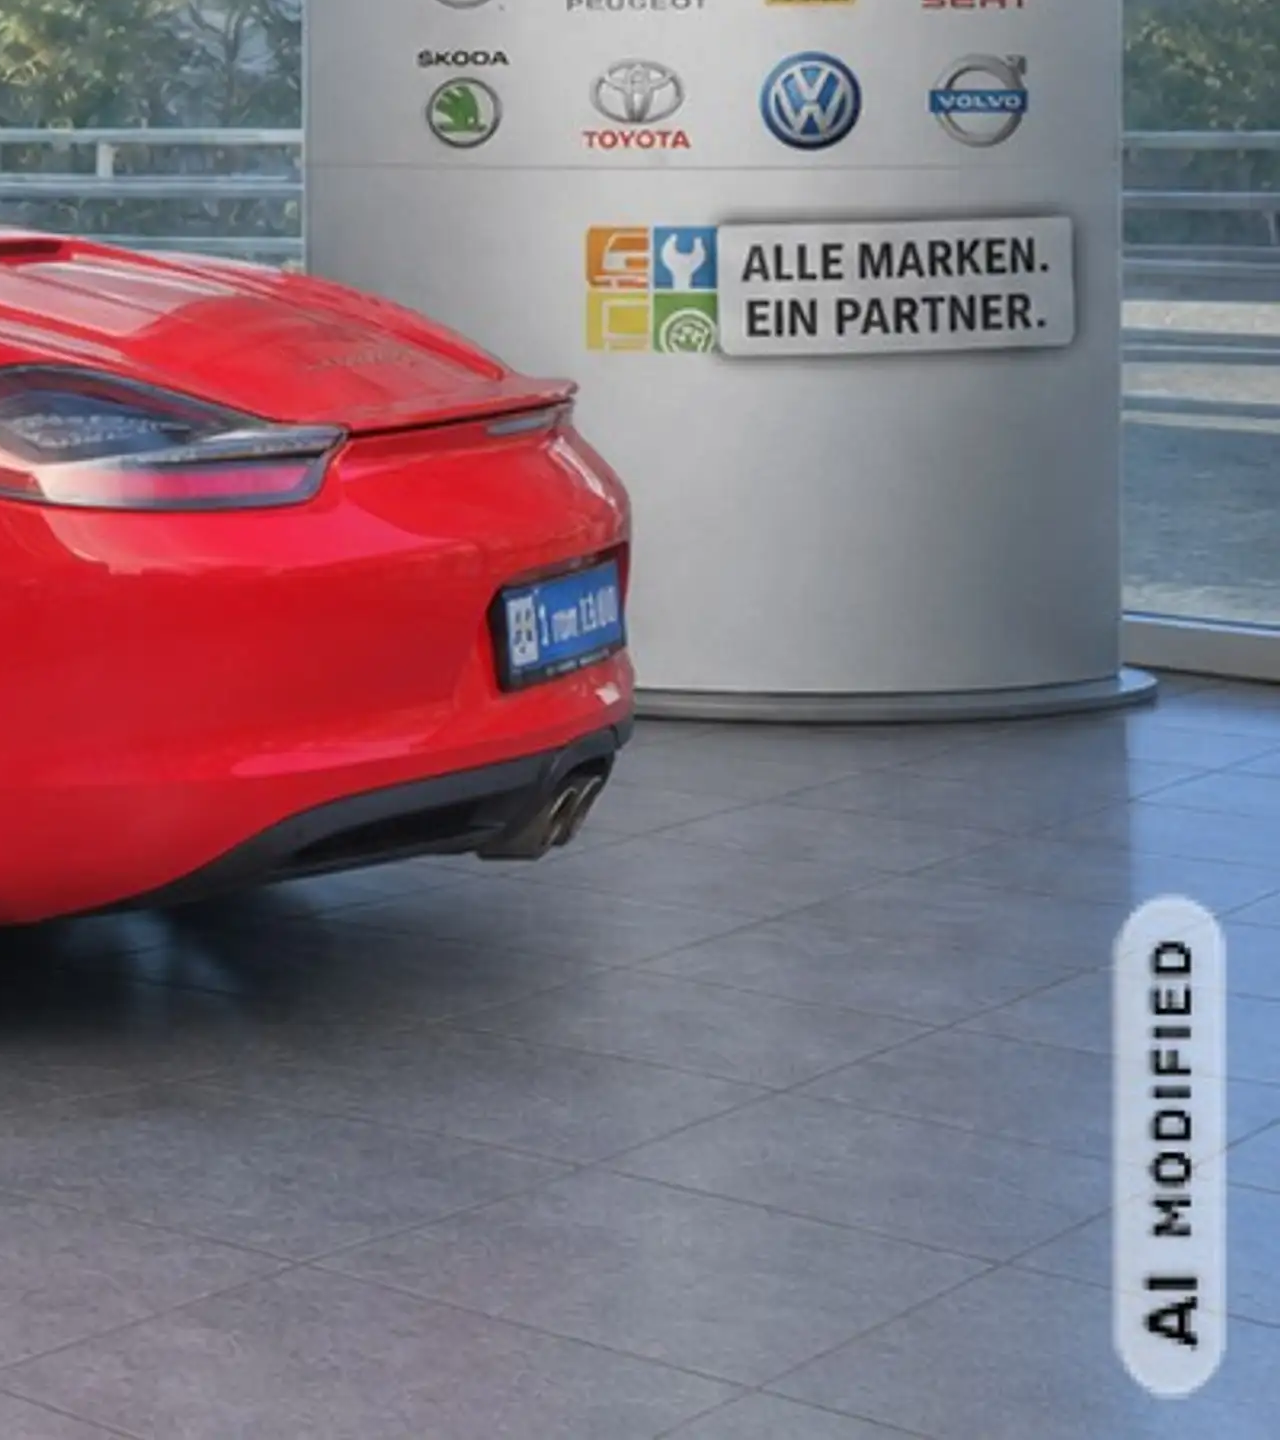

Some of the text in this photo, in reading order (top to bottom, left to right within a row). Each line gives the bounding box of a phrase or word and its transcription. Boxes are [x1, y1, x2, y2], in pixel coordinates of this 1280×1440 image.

[938, 93, 1023, 109] VOLVO
[583, 130, 691, 150] TOYOTA
[742, 238, 1049, 282] ALLE MARKEN.
[746, 294, 1046, 337] EIN PARTNER.
